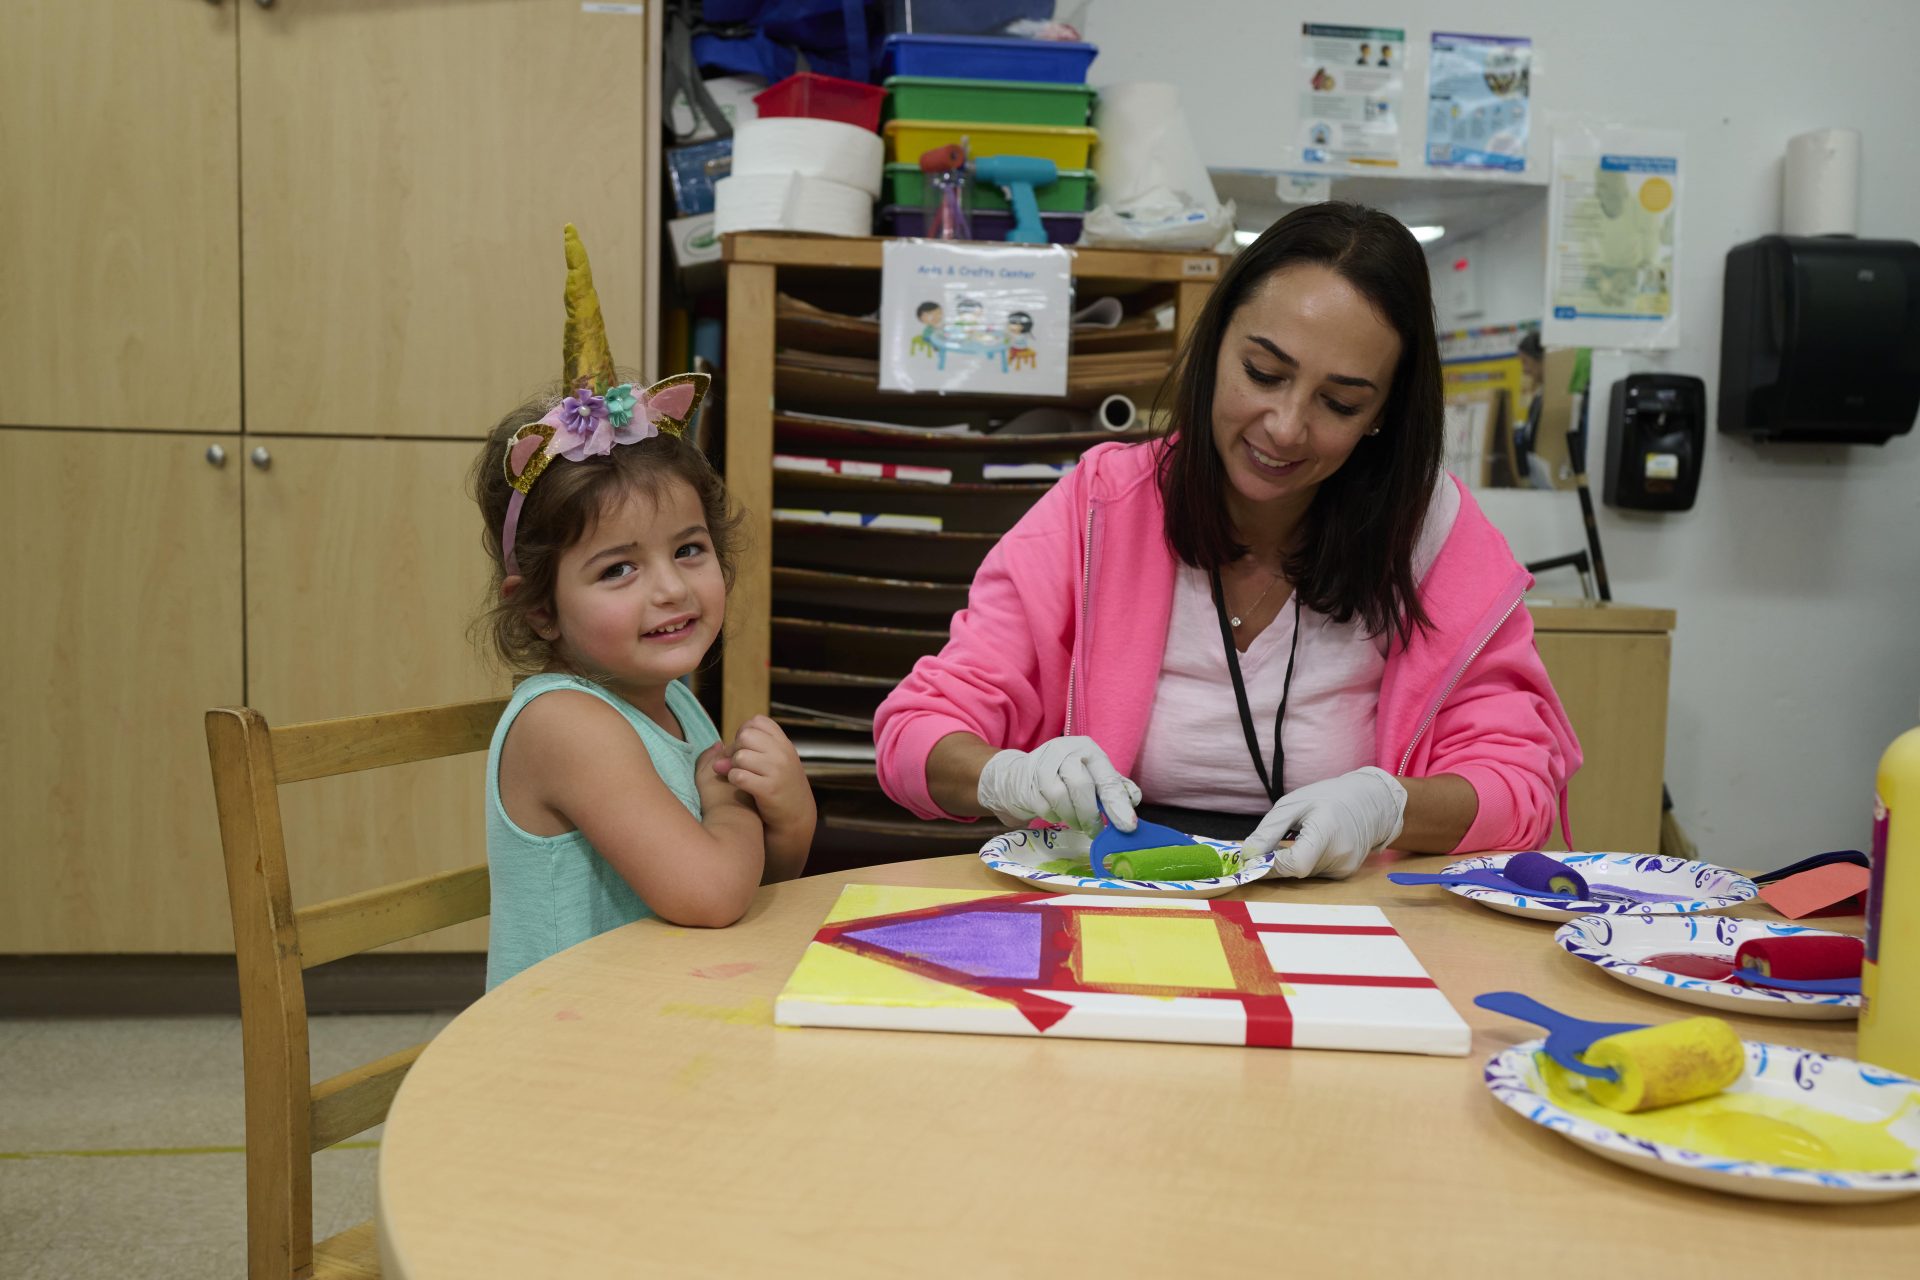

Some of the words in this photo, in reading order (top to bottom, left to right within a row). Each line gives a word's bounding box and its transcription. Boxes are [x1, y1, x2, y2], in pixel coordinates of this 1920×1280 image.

[917, 265, 942, 276] Arts
[947, 265, 955, 275] &
[959, 265, 994, 278] Crafts
[999, 267, 1035, 279] Center
